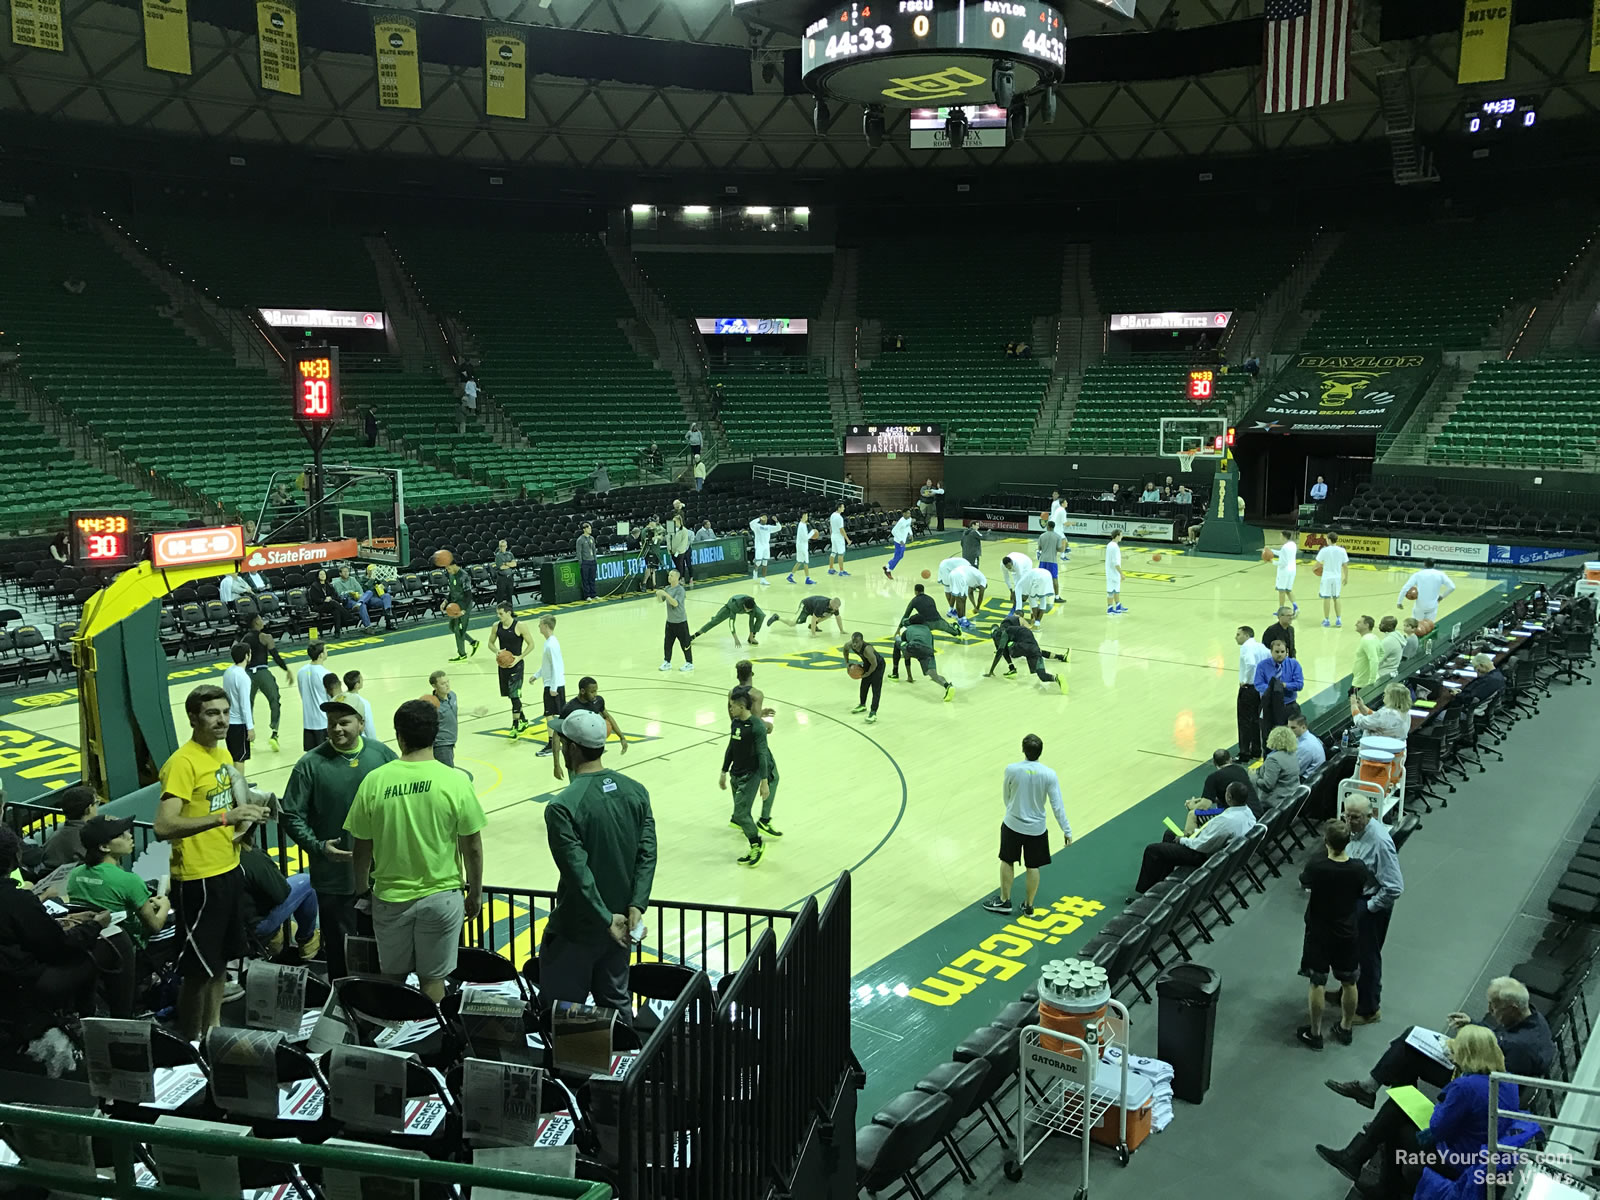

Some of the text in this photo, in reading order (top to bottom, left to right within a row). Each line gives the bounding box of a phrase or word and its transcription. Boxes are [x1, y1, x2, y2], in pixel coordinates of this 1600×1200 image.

[861, 6, 870, 17] 4
[984, 1, 1027, 18] BAYLOR
[1039, 11, 1046, 22] 4
[1468, 7, 1507, 23] NIVC
[913, 15, 929, 37] 0
[991, 17, 1006, 40] 0
[1053, 18, 1060, 29] 4
[808, 39, 816, 59] 0
[825, 25, 893, 58] 44:33
[1022, 29, 1064, 66] 44:33
[1470, 118, 1481, 133] 0
[1524, 111, 1536, 127] 0
[299, 360, 329, 379] 44:33
[1296, 355, 1425, 369] BAYLOR
[304, 380, 327, 414] 30
[1193, 381, 1210, 396] 30
[866, 444, 920, 453] BASKETBALL
[877, 435, 909, 445] BAYLOR
[77, 517, 127, 534] 44:33
[986, 513, 1004, 521] Waco
[997, 521, 1019, 530] Herald
[89, 535, 117, 558] 30
[699, 544, 725, 564] ARENA
[384, 780, 433, 800] #ALLINBU
[1031, 1053, 1078, 1075] GATORADE
[298, 1088, 323, 1115] ACME
[411, 1101, 436, 1130] ACME
[420, 1102, 444, 1130] BRICK
[538, 1116, 563, 1145] ACME
[548, 1118, 572, 1146] BRICK
